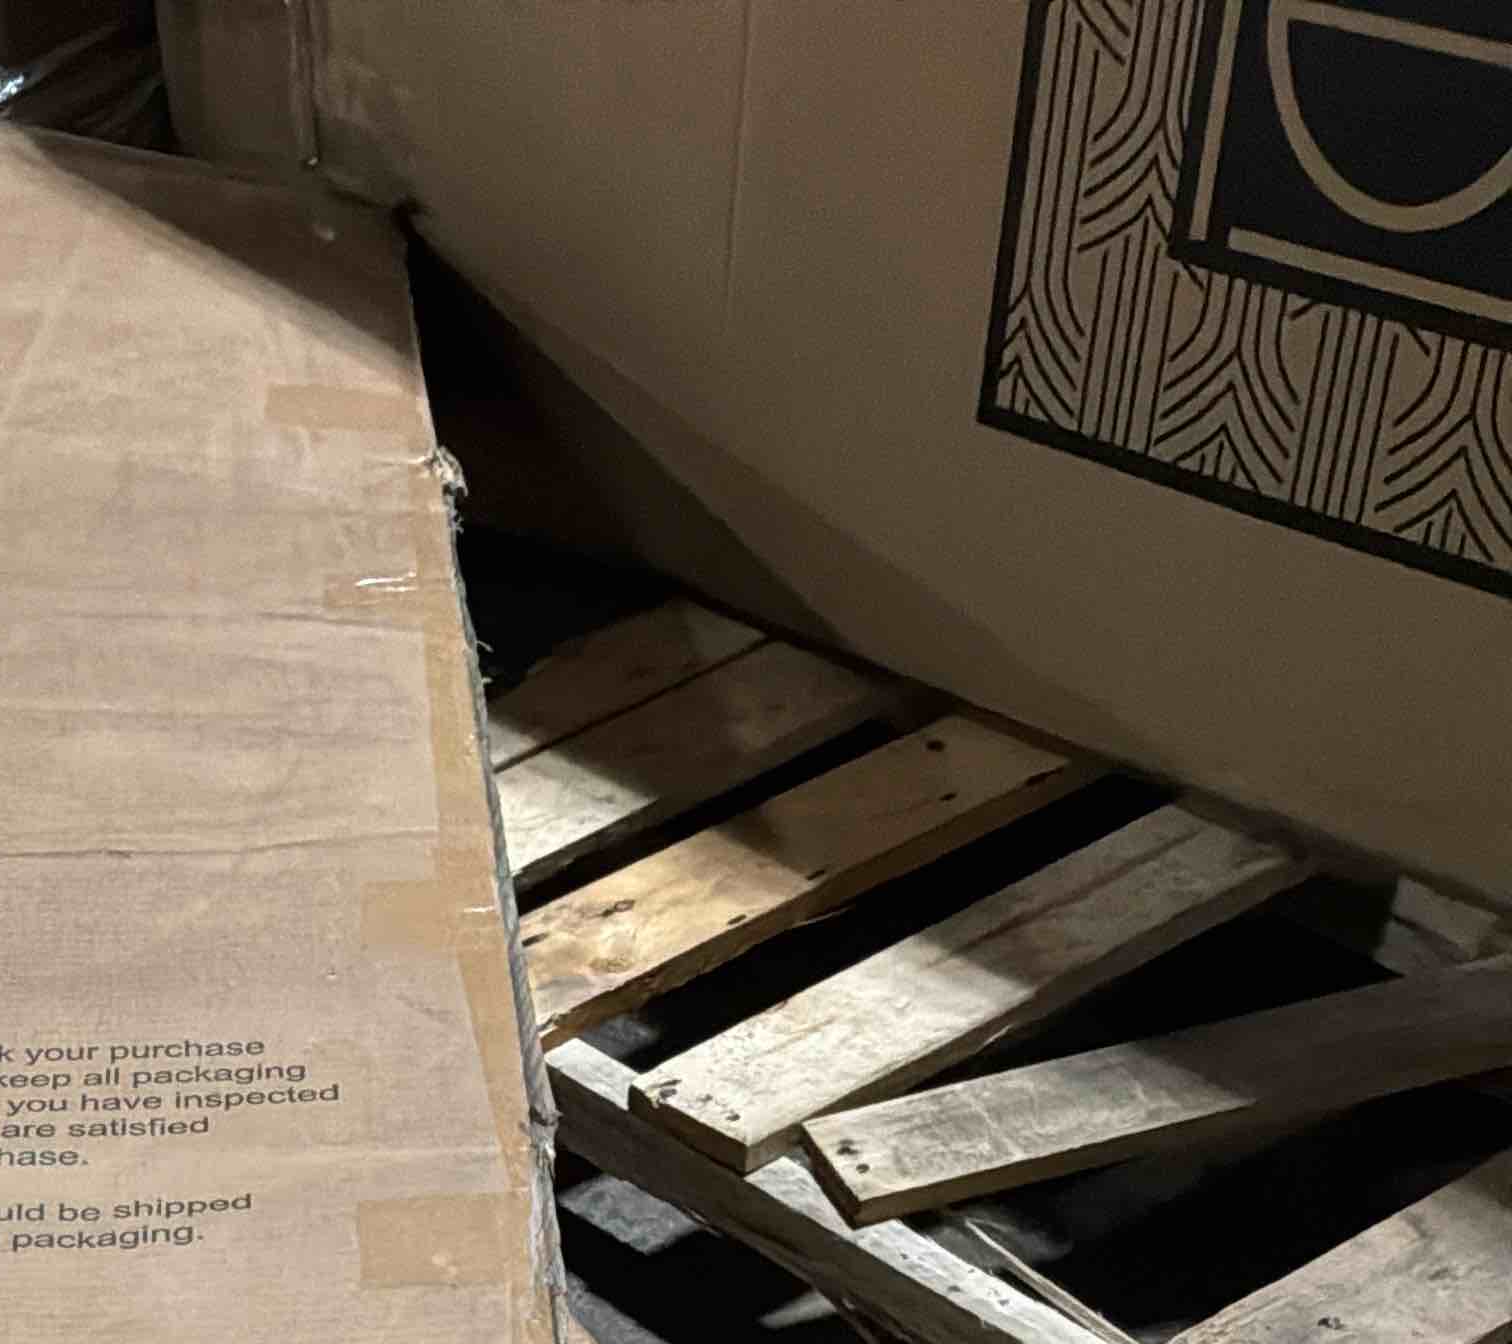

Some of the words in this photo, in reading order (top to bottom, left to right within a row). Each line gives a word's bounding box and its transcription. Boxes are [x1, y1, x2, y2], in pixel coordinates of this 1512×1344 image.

[25, 1046, 99, 1066] your
[110, 1040, 265, 1063] purchase
[83, 1068, 120, 1086] all
[132, 1063, 306, 1088] packaging
[6, 1099, 67, 1117] you
[81, 1093, 162, 1112] have
[175, 1084, 340, 1110] inspected
[1, 1123, 56, 1138] are
[68, 1116, 209, 1137] satisfied
[58, 1203, 101, 1222] be
[113, 1193, 252, 1219] shipped
[12, 1226, 204, 1252] packaging.
